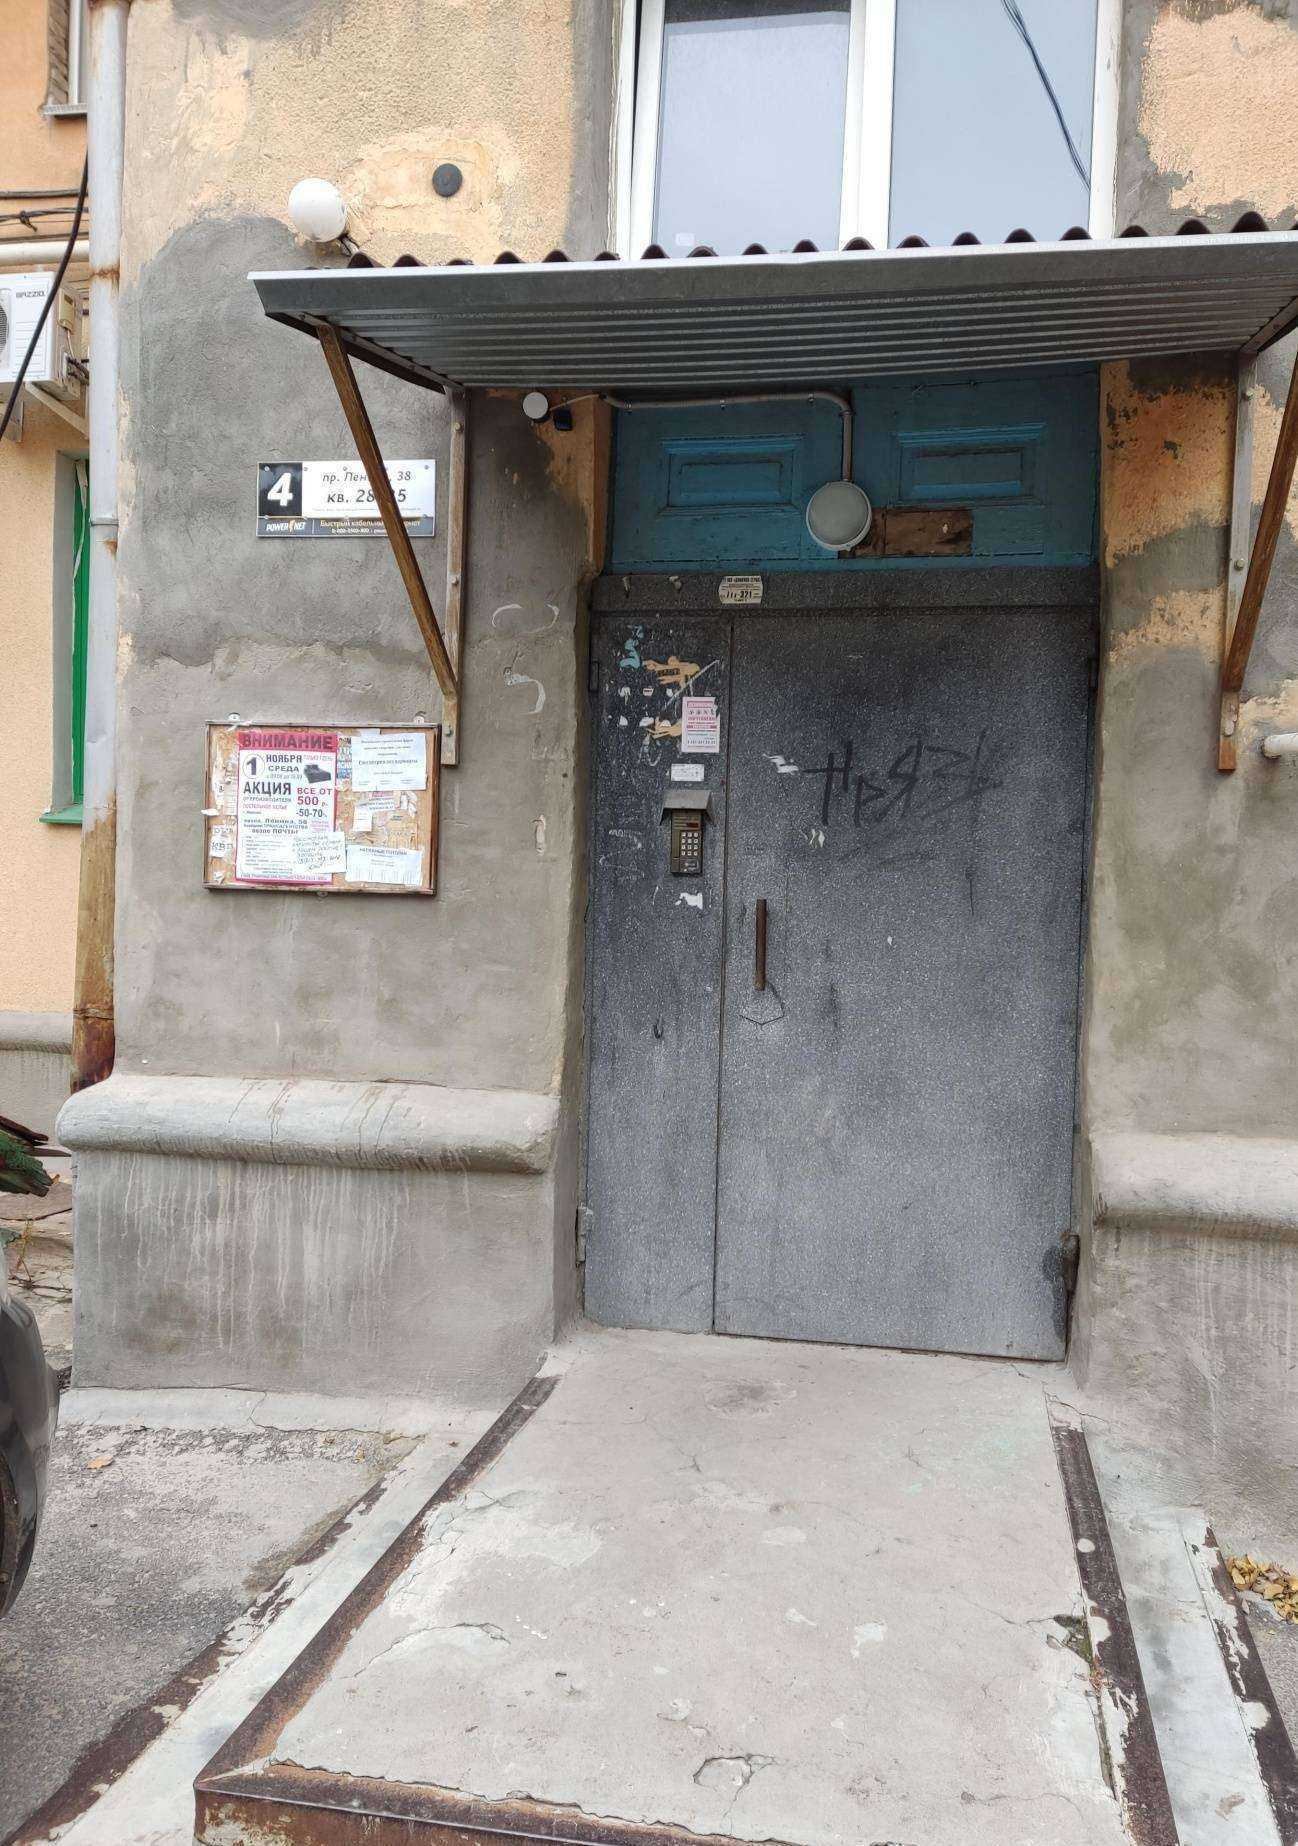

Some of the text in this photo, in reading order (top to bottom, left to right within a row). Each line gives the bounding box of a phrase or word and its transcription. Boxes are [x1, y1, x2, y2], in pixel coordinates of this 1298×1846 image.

[322, 474, 340, 485] пр.
[397, 471, 412, 481] 38
[267, 472, 293, 507] 4
[327, 493, 349, 503] кв.
[242, 732, 333, 750] ВНИМАНИЕ
[266, 754, 302, 763] НОЯБРЯ
[246, 756, 257, 776] 1
[268, 765, 300, 773] СРЕДА
[243, 781, 292, 796] АКЦИЯ
[297, 787, 333, 796] ВСЕ ОТ
[297, 795, 319, 806] 500
